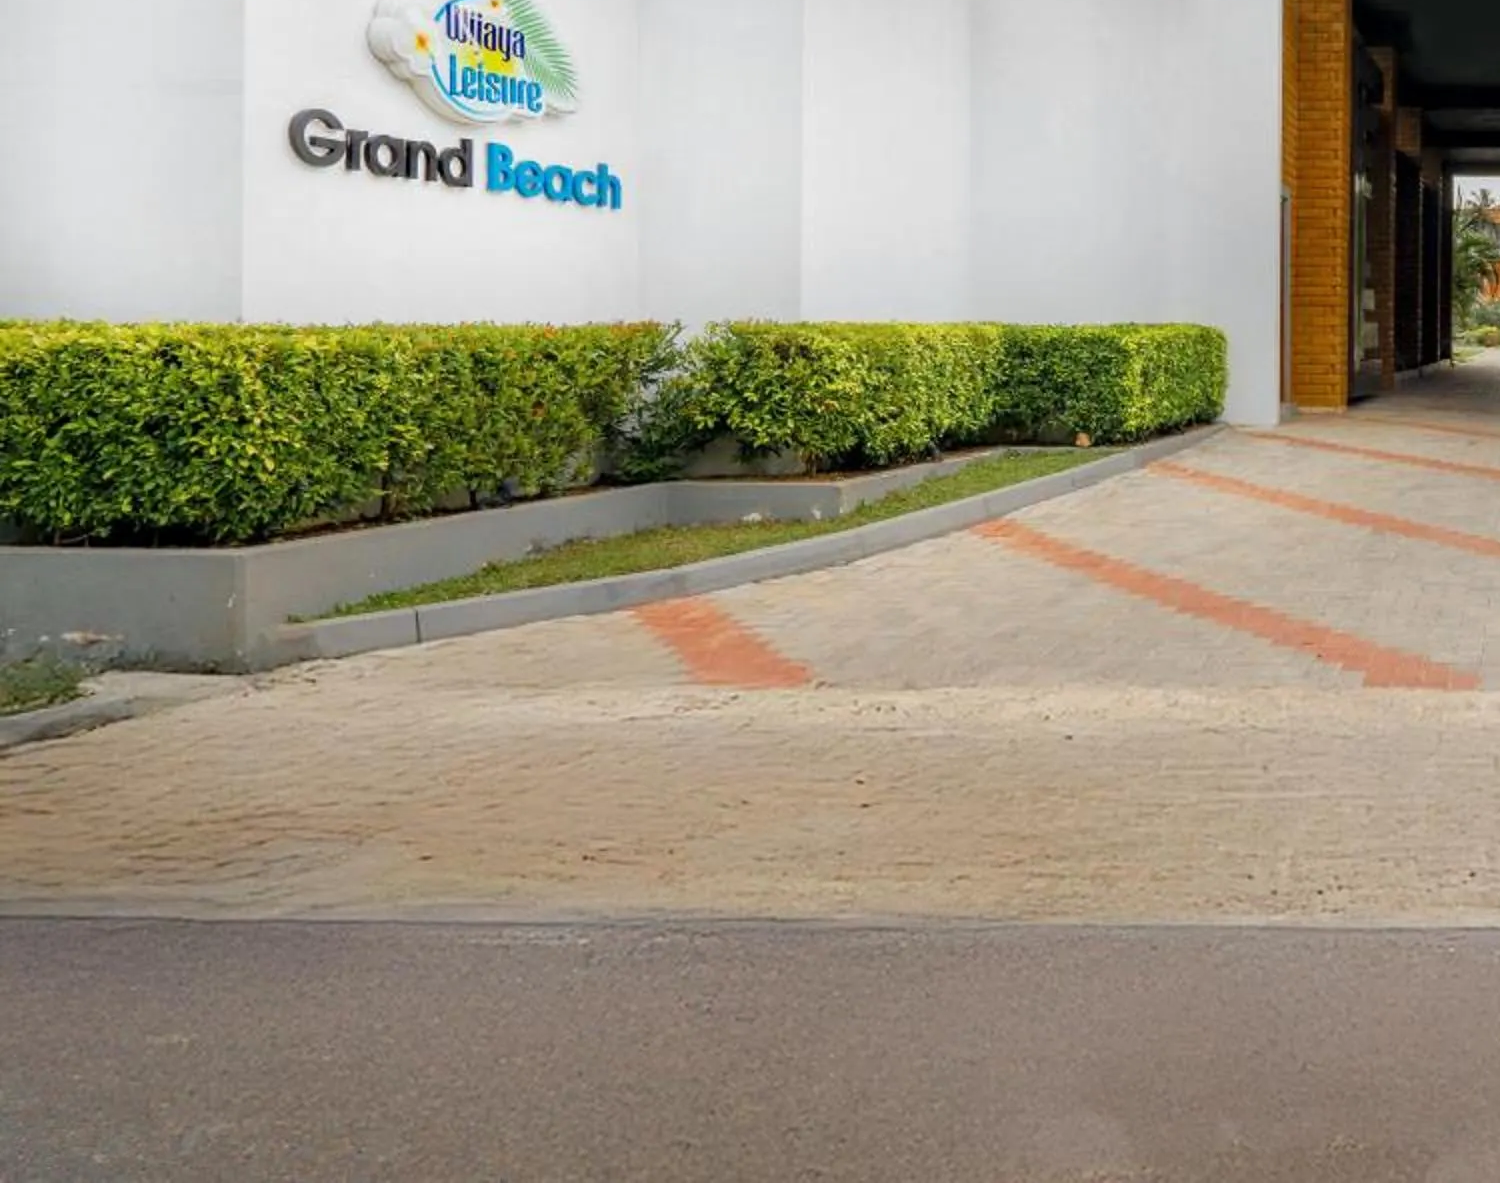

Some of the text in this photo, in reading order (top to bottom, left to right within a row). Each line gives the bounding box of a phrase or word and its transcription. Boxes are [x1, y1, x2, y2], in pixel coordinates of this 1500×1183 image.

[445, 4, 526, 61] Wijaya
[449, 54, 543, 112] Leisure
[288, 108, 622, 209] Grand Beach
